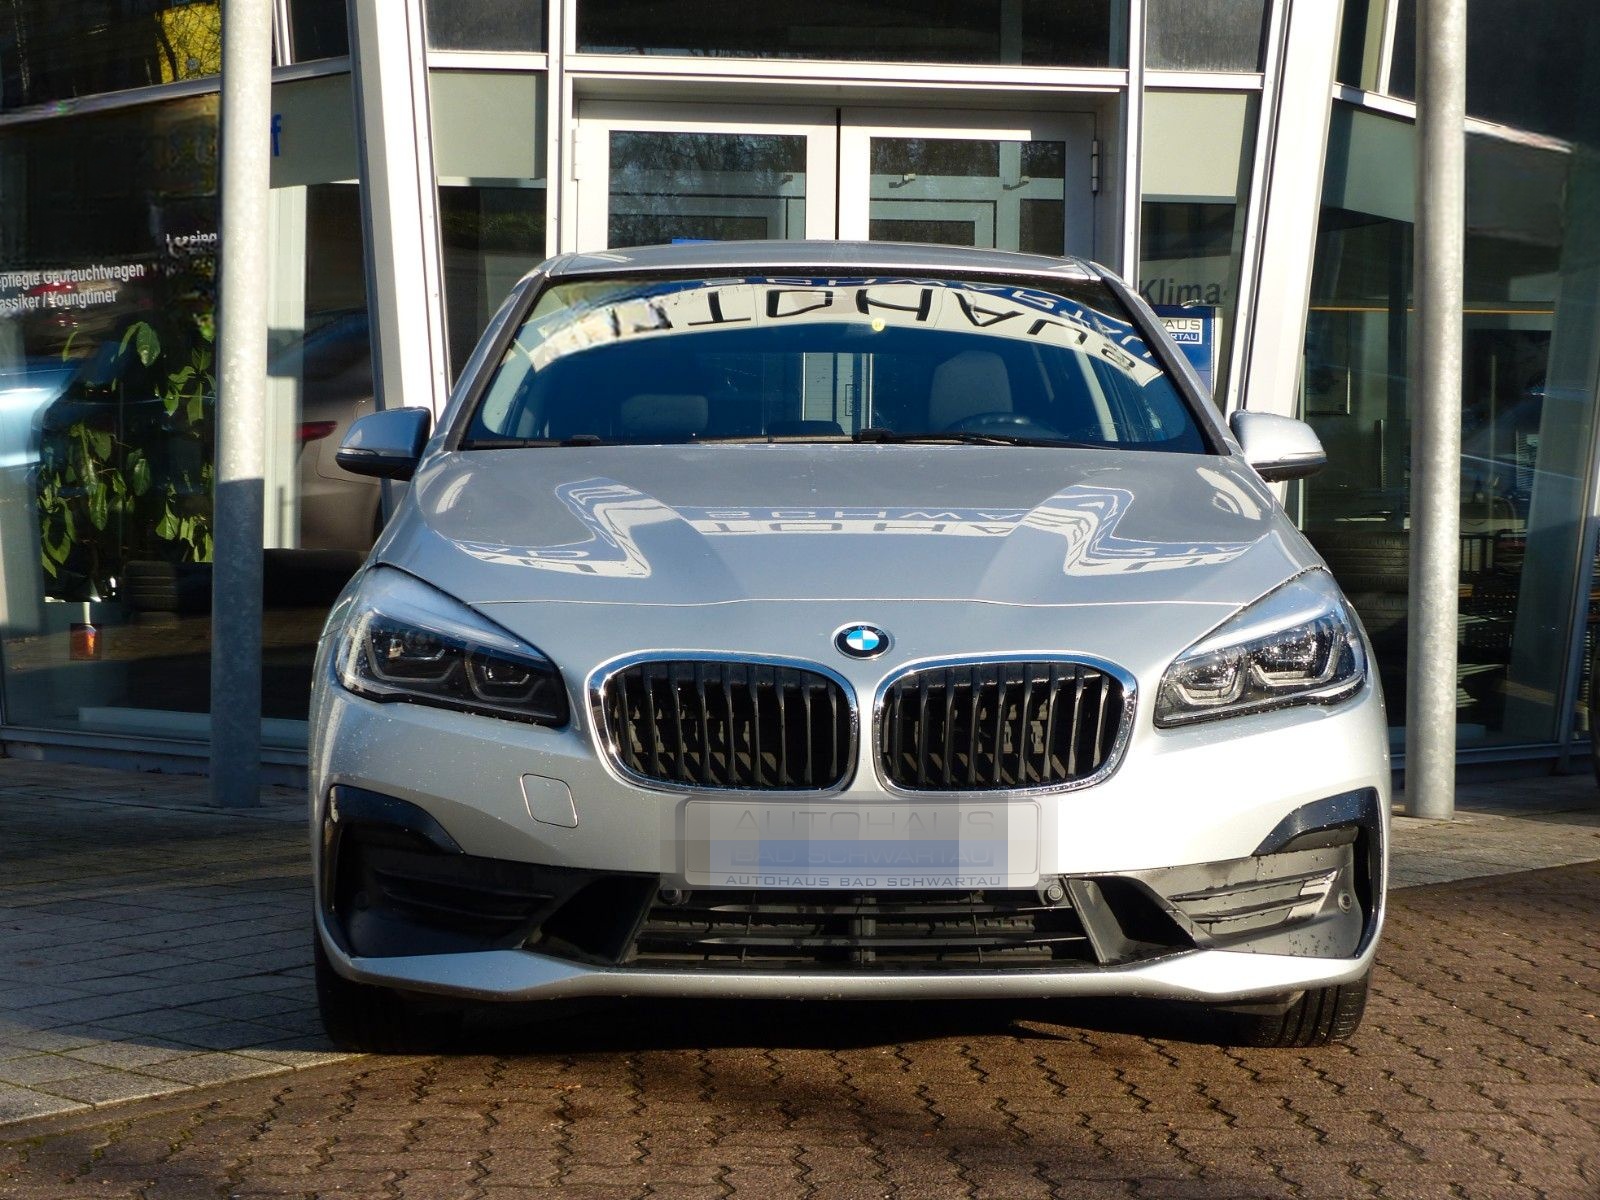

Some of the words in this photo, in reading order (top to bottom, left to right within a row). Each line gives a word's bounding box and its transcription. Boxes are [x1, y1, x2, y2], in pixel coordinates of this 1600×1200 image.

[0, 271, 40, 292] pflegte
[43, 263, 145, 284] Gebrauchtwagen
[48, 289, 118, 307] Youngtimer
[732, 809, 996, 838] AUTOHAUS
[725, 875, 831, 887] AUTOHAUS
[839, 876, 877, 888] BAD
[886, 876, 1001, 888] SCHWARTAU
